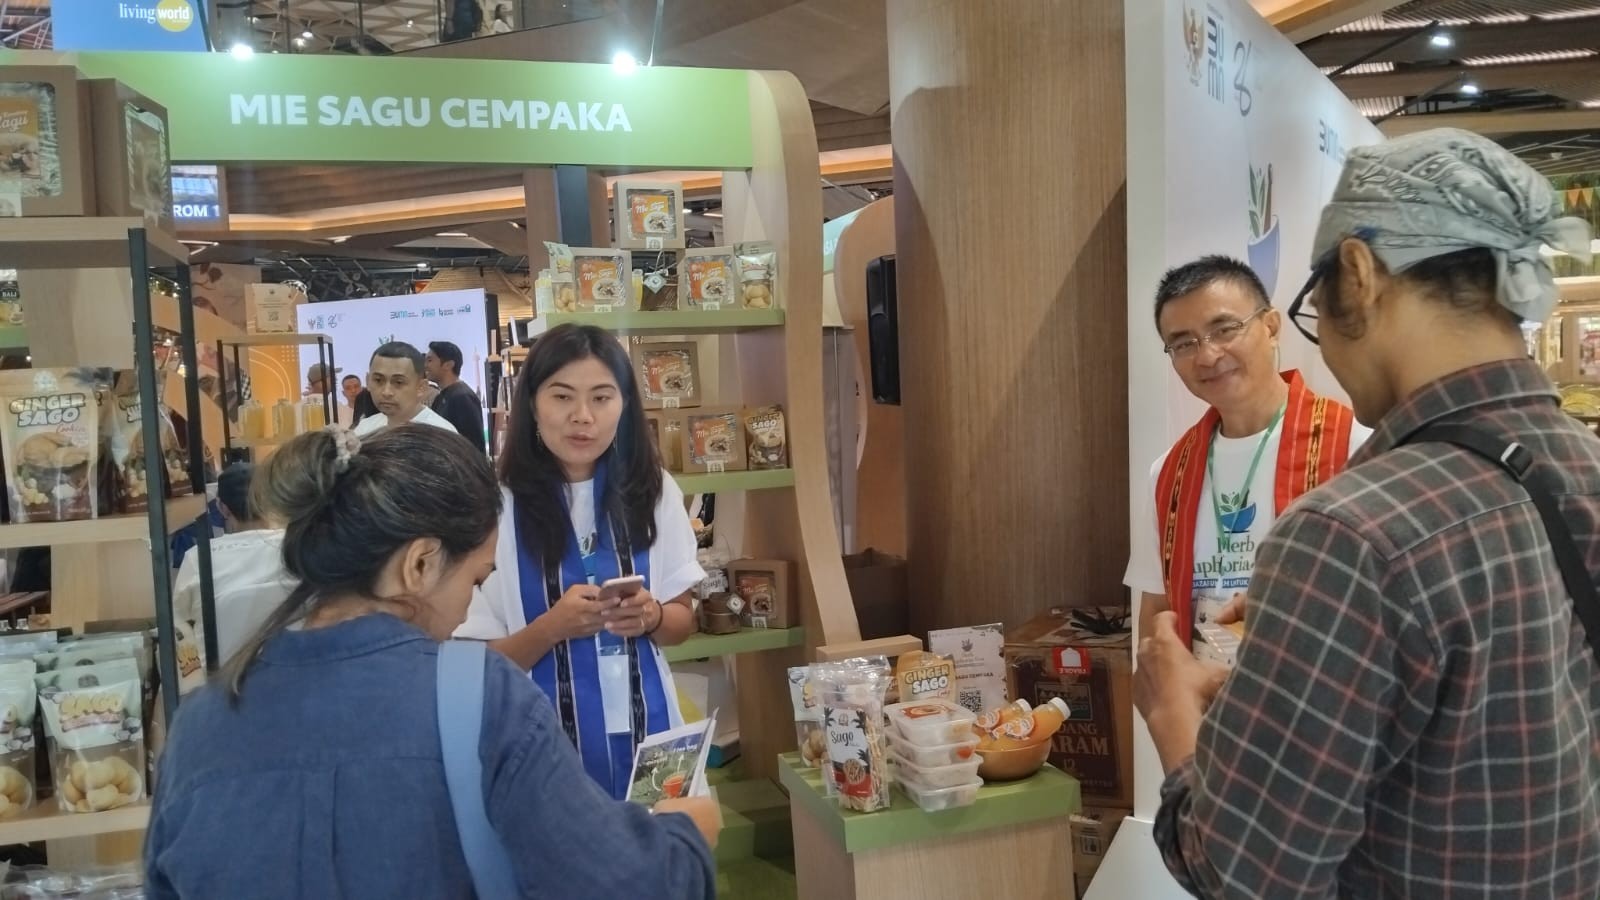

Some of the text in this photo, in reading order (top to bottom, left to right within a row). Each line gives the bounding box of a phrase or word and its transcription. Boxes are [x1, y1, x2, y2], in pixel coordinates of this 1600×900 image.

[119, 3, 190, 24] living world
[0, 111, 29, 132] agu
[230, 93, 632, 132] MIE SAGU CEMPAKA
[212, 204, 220, 217] 1
[9, 392, 87, 415] GINGER
[17, 407, 81, 427] SAGO
[752, 419, 777, 430] SAGO
[1217, 535, 1255, 554] Herb
[1193, 555, 1250, 578] uphoria
[904, 664, 950, 685] GINGER
[912, 676, 949, 695] SAGO
[1060, 722, 1097, 735] DANG
[831, 731, 854, 747] Sago
[1051, 735, 1109, 756] ARAM
